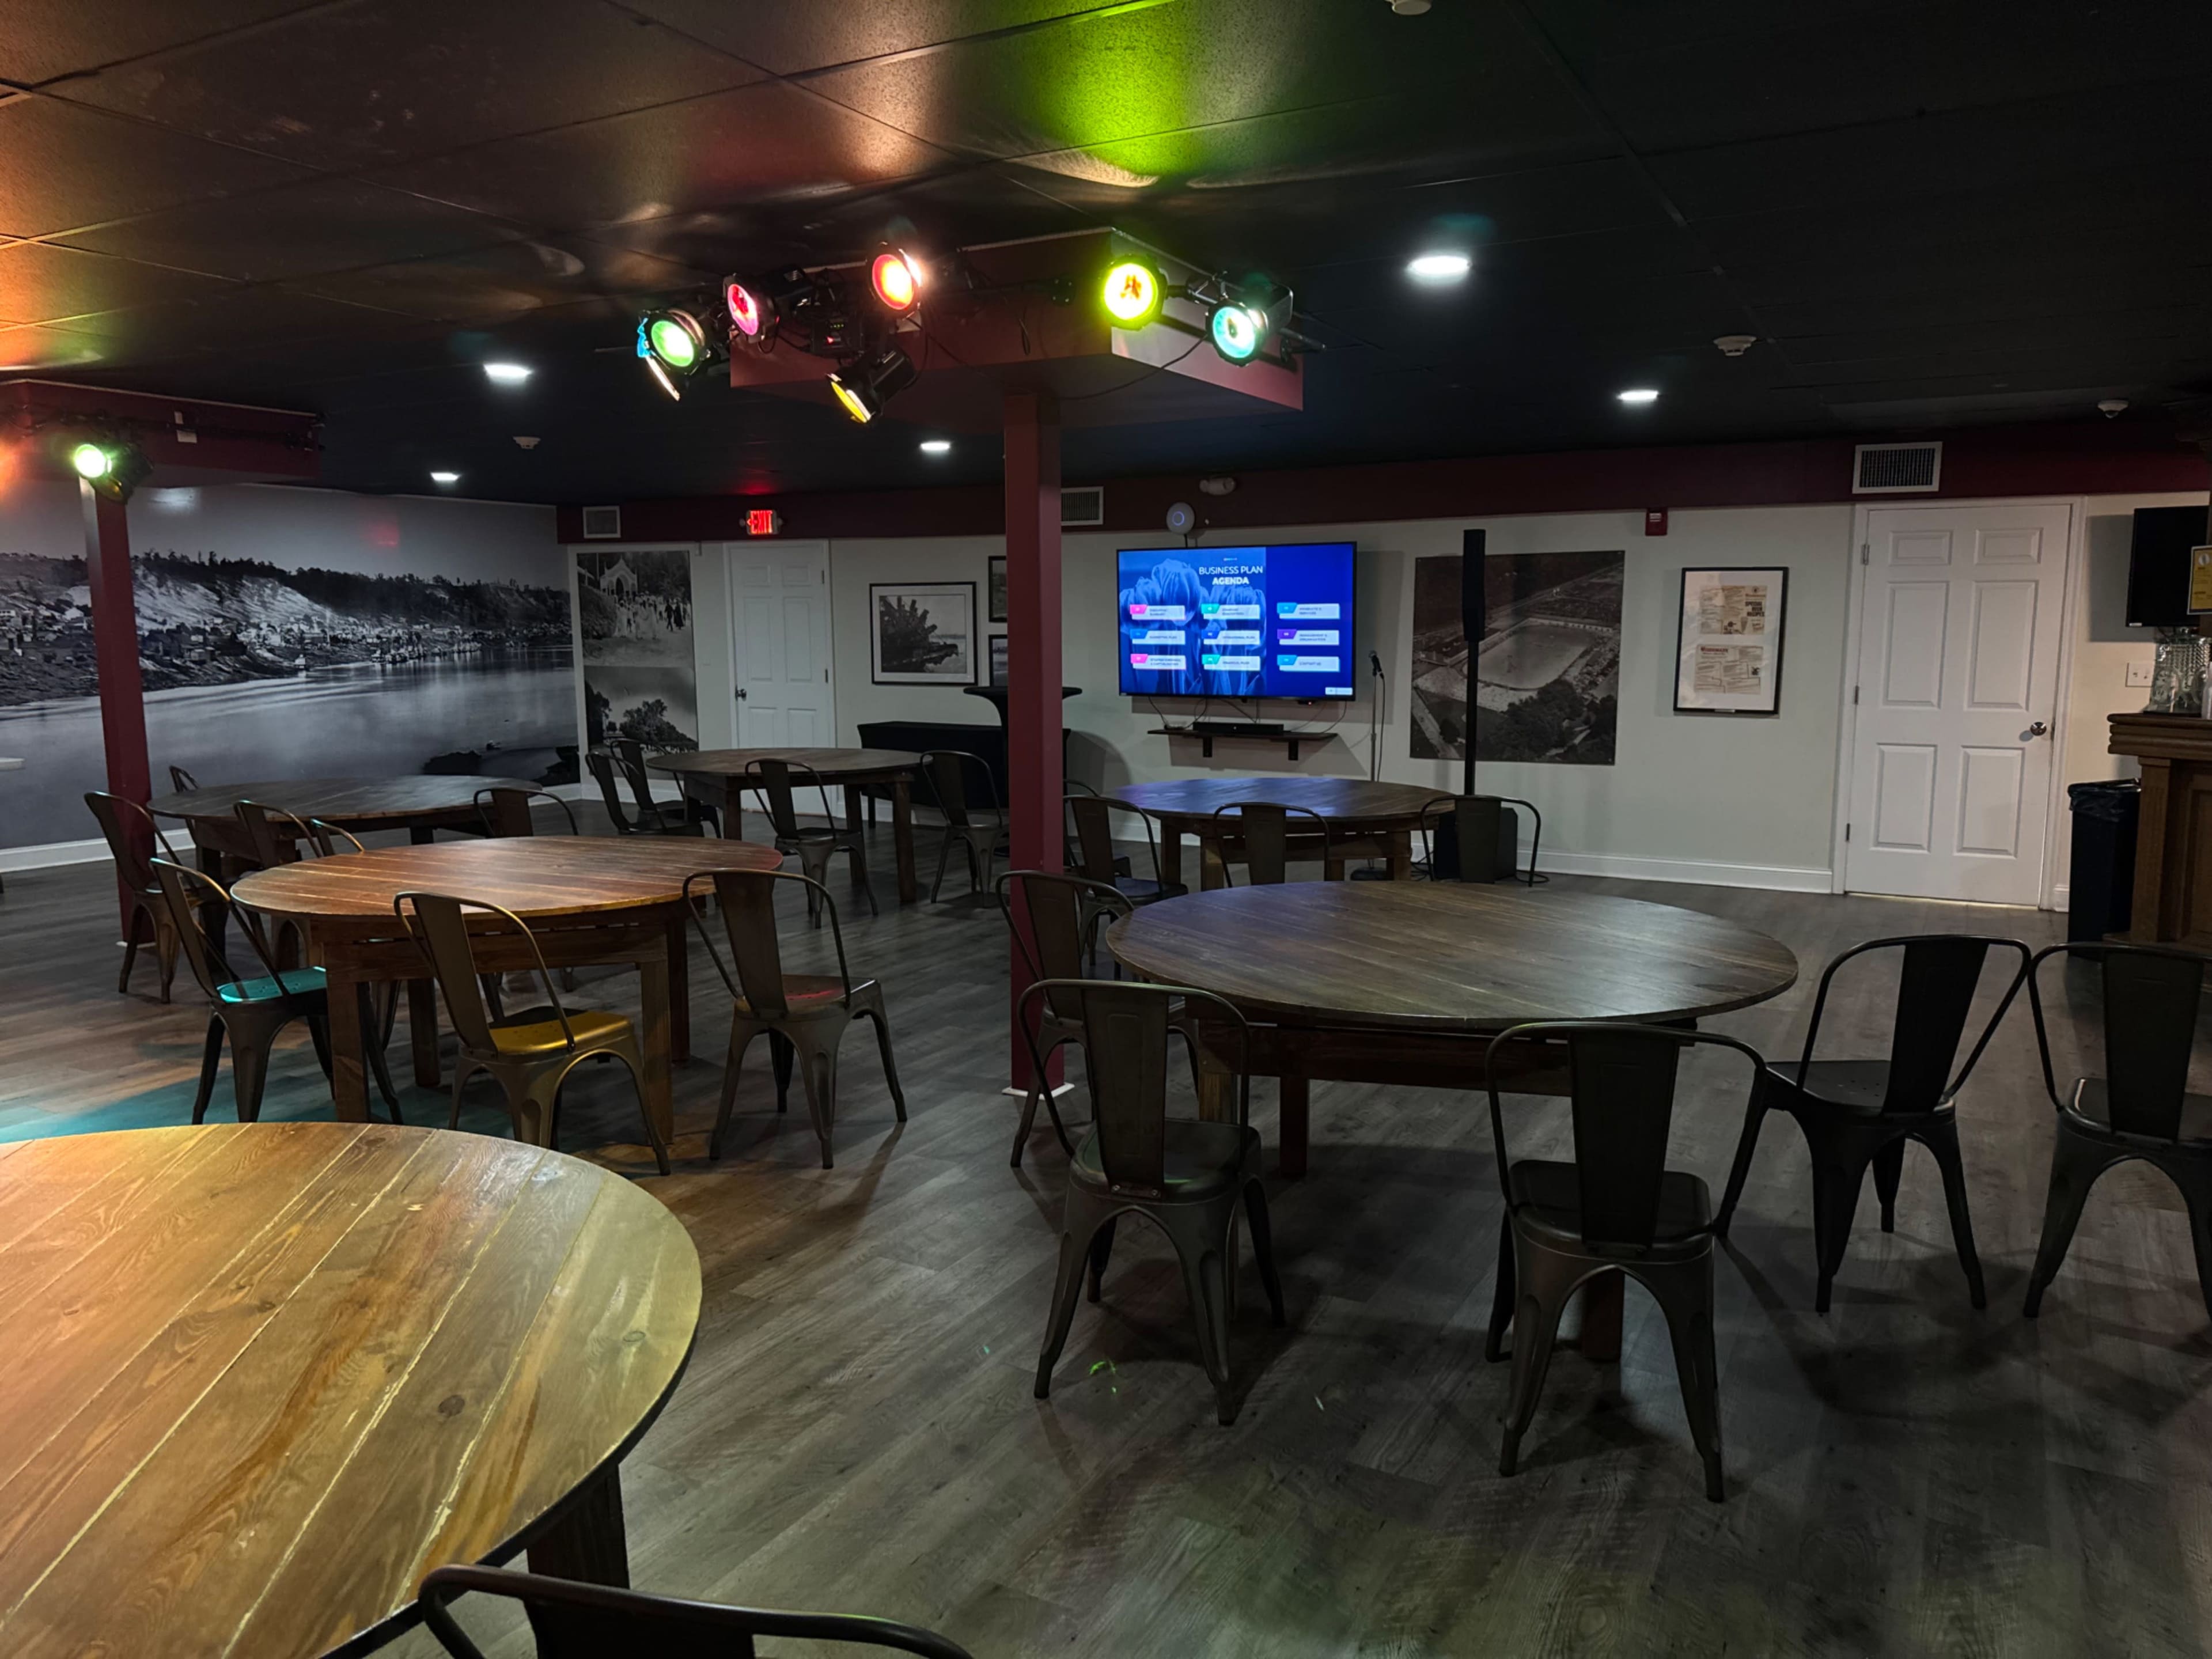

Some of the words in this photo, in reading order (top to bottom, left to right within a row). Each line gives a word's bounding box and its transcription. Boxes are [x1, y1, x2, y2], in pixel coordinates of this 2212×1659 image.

[750, 510, 773, 534] EXIT
[1199, 566, 1239, 575] BUSINESS
[1240, 566, 1263, 574] PLAN
[1212, 577, 1249, 585] AGENDA
